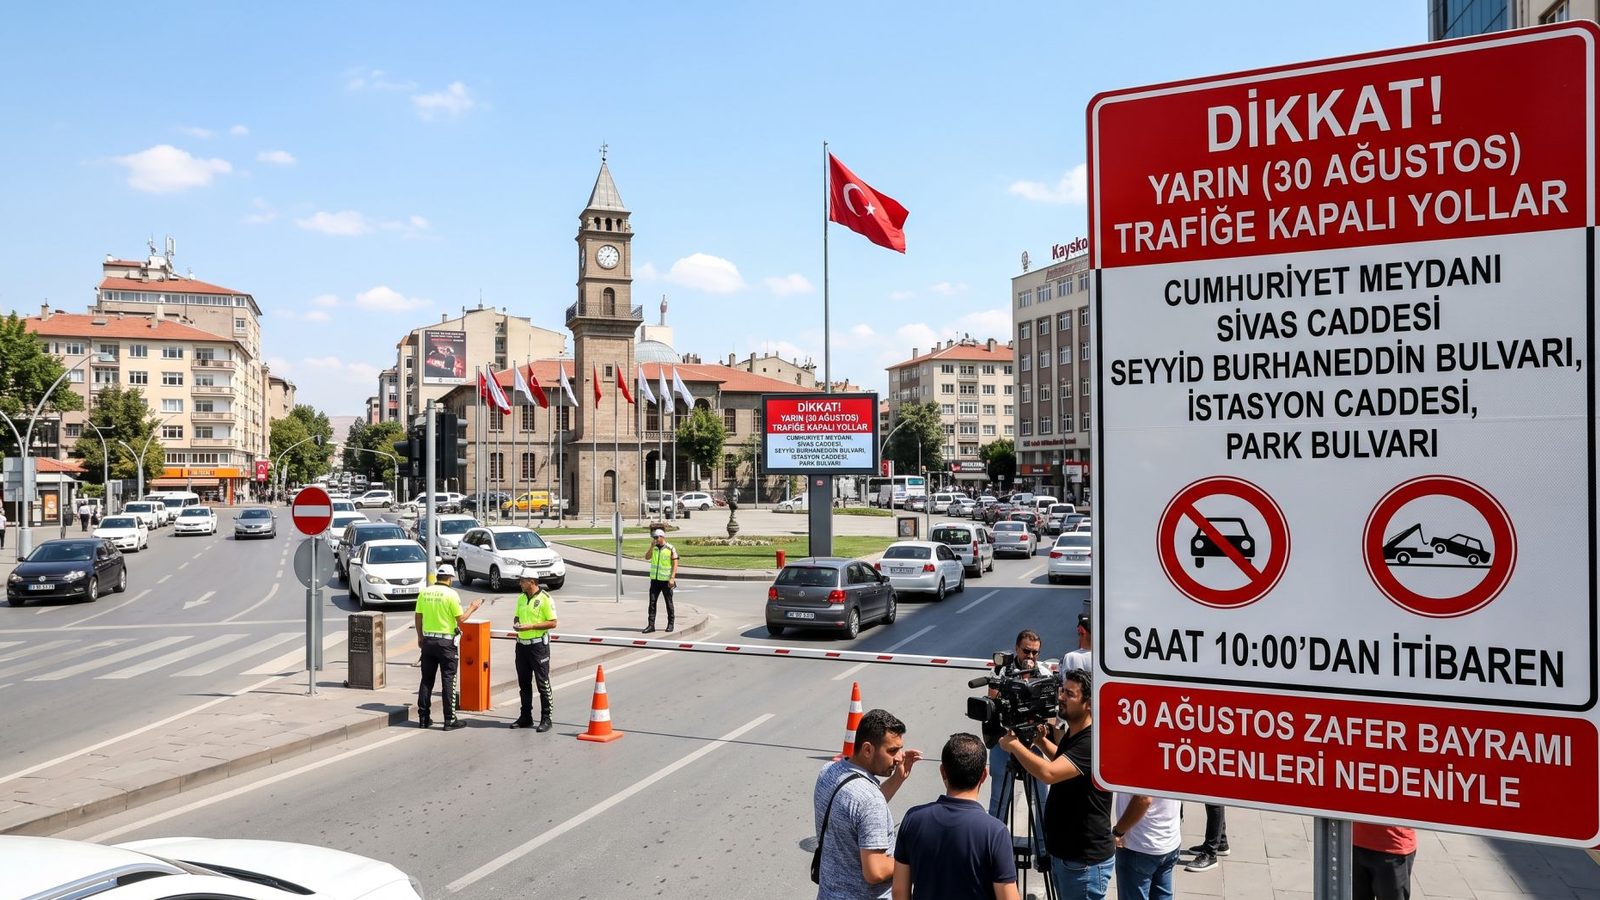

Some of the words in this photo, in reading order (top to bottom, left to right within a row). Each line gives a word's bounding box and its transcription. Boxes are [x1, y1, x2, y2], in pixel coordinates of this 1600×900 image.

[1207, 76, 1442, 153] DİKKAT!
[1148, 165, 1249, 205] YARIN
[1262, 158, 1313, 203] (30
[1323, 132, 1521, 187] AĞUSTOS)
[1114, 205, 1256, 254] TRAFİĞE
[1269, 196, 1396, 240] KAPALI
[1408, 180, 1569, 227] YOLLAR
[1164, 263, 1351, 307] CUMHURİYET
[1359, 254, 1502, 293] MEYDANI
[1216, 307, 1298, 343] SİVAS
[1307, 294, 1440, 337] CADDESİ
[1110, 350, 1204, 386] SEYYİD
[1213, 338, 1425, 382] BURHANEDDİN
[1436, 336, 1582, 373] BULVARI,
[781, 414, 804, 422] YARIN
[805, 414, 817, 423] (30
[818, 412, 859, 423] AĞUSTOS)
[797, 401, 842, 412] DİKKAT!
[1188, 388, 1325, 422] İSTASYON
[1334, 377, 1478, 420] CADDESİ,
[772, 422, 805, 431] TRAFİĞE
[807, 423, 835, 431] KAPALI
[836, 423, 868, 431] YOLLAR
[1226, 431, 1303, 460] PARK
[1311, 428, 1438, 459] BULVARI
[1123, 626, 1205, 663] SAAT
[1215, 631, 1380, 676] 10:00’DAN
[1393, 633, 1565, 689] İTİBAREN
[1117, 698, 1147, 727] 30
[1154, 695, 1294, 740] AĞUSTOS
[1303, 713, 1407, 751] ZAFER
[1418, 723, 1572, 766] BAYRAMI
[1158, 738, 1324, 787] TÖRENLERİ
[1335, 759, 1520, 808] NEDENİYLE
